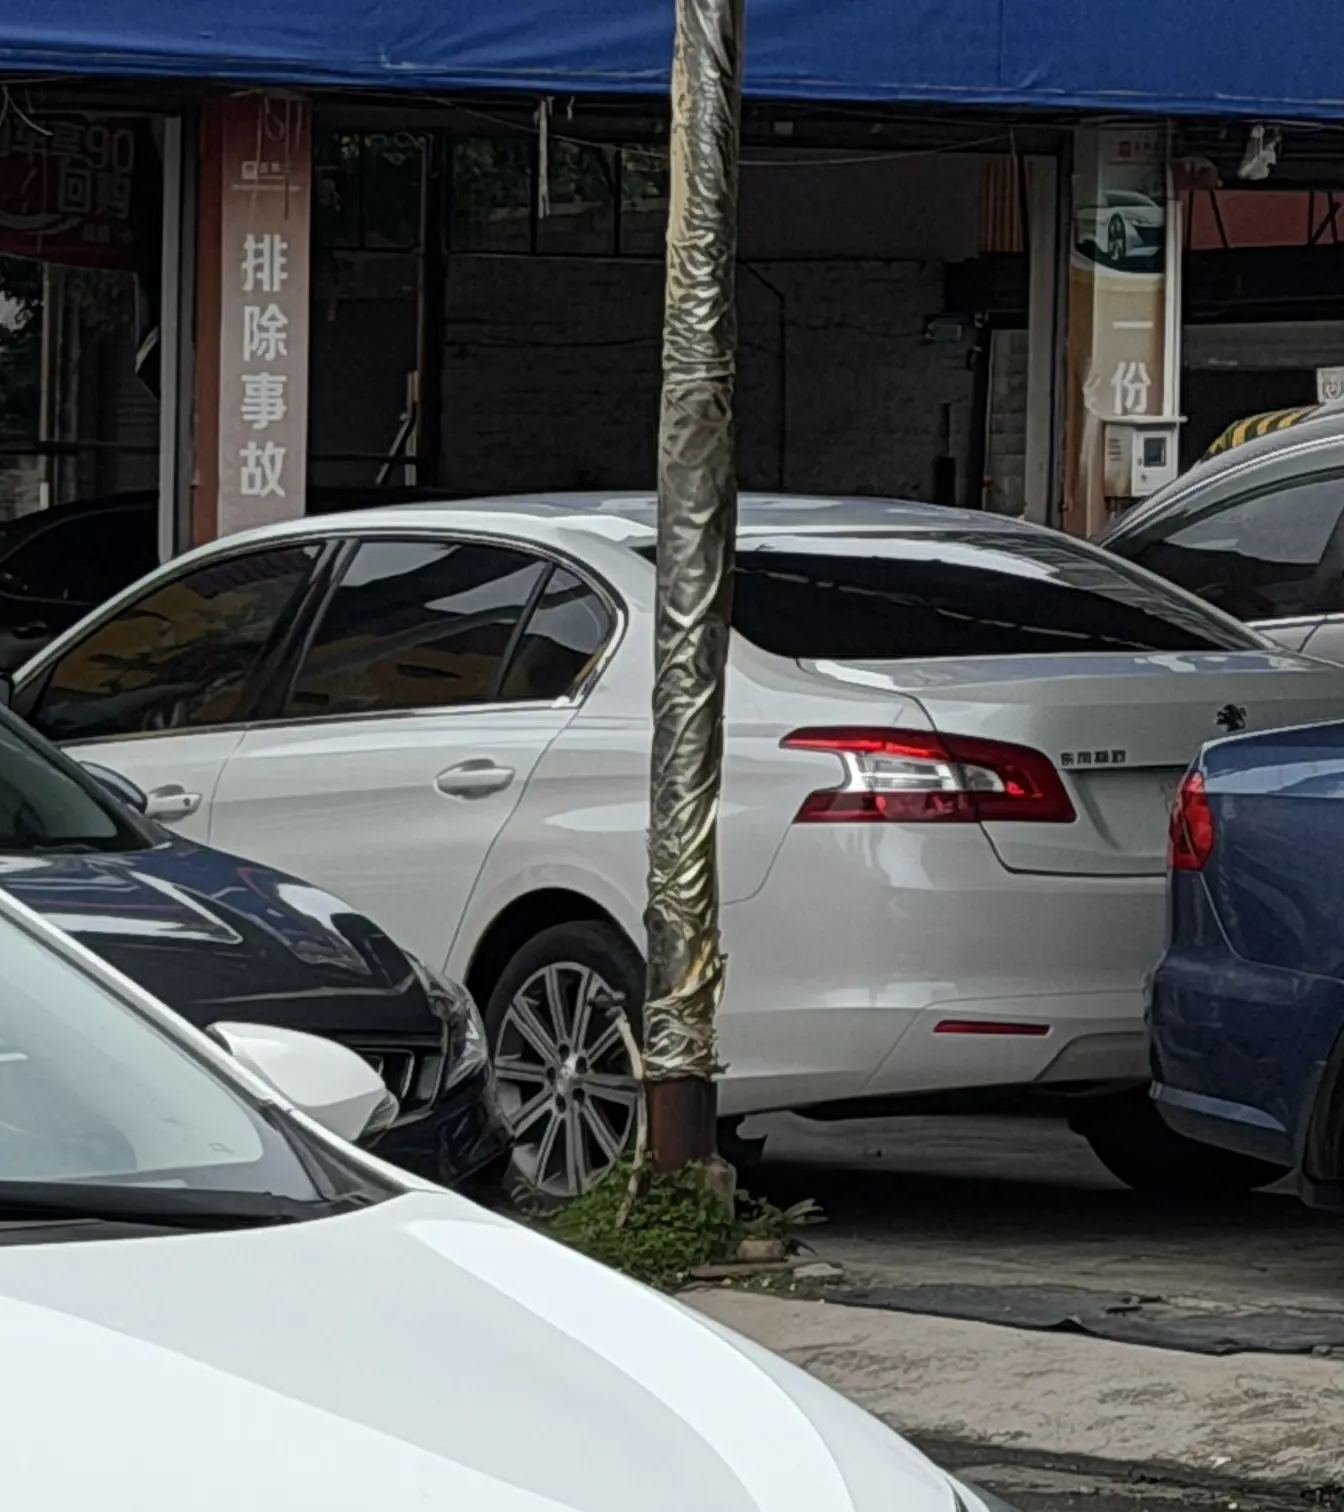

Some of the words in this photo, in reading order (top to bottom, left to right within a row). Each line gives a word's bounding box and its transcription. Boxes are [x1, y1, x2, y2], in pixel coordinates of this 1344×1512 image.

[239, 233, 289, 498] 排除事故
[1111, 320, 1153, 415] 一份
